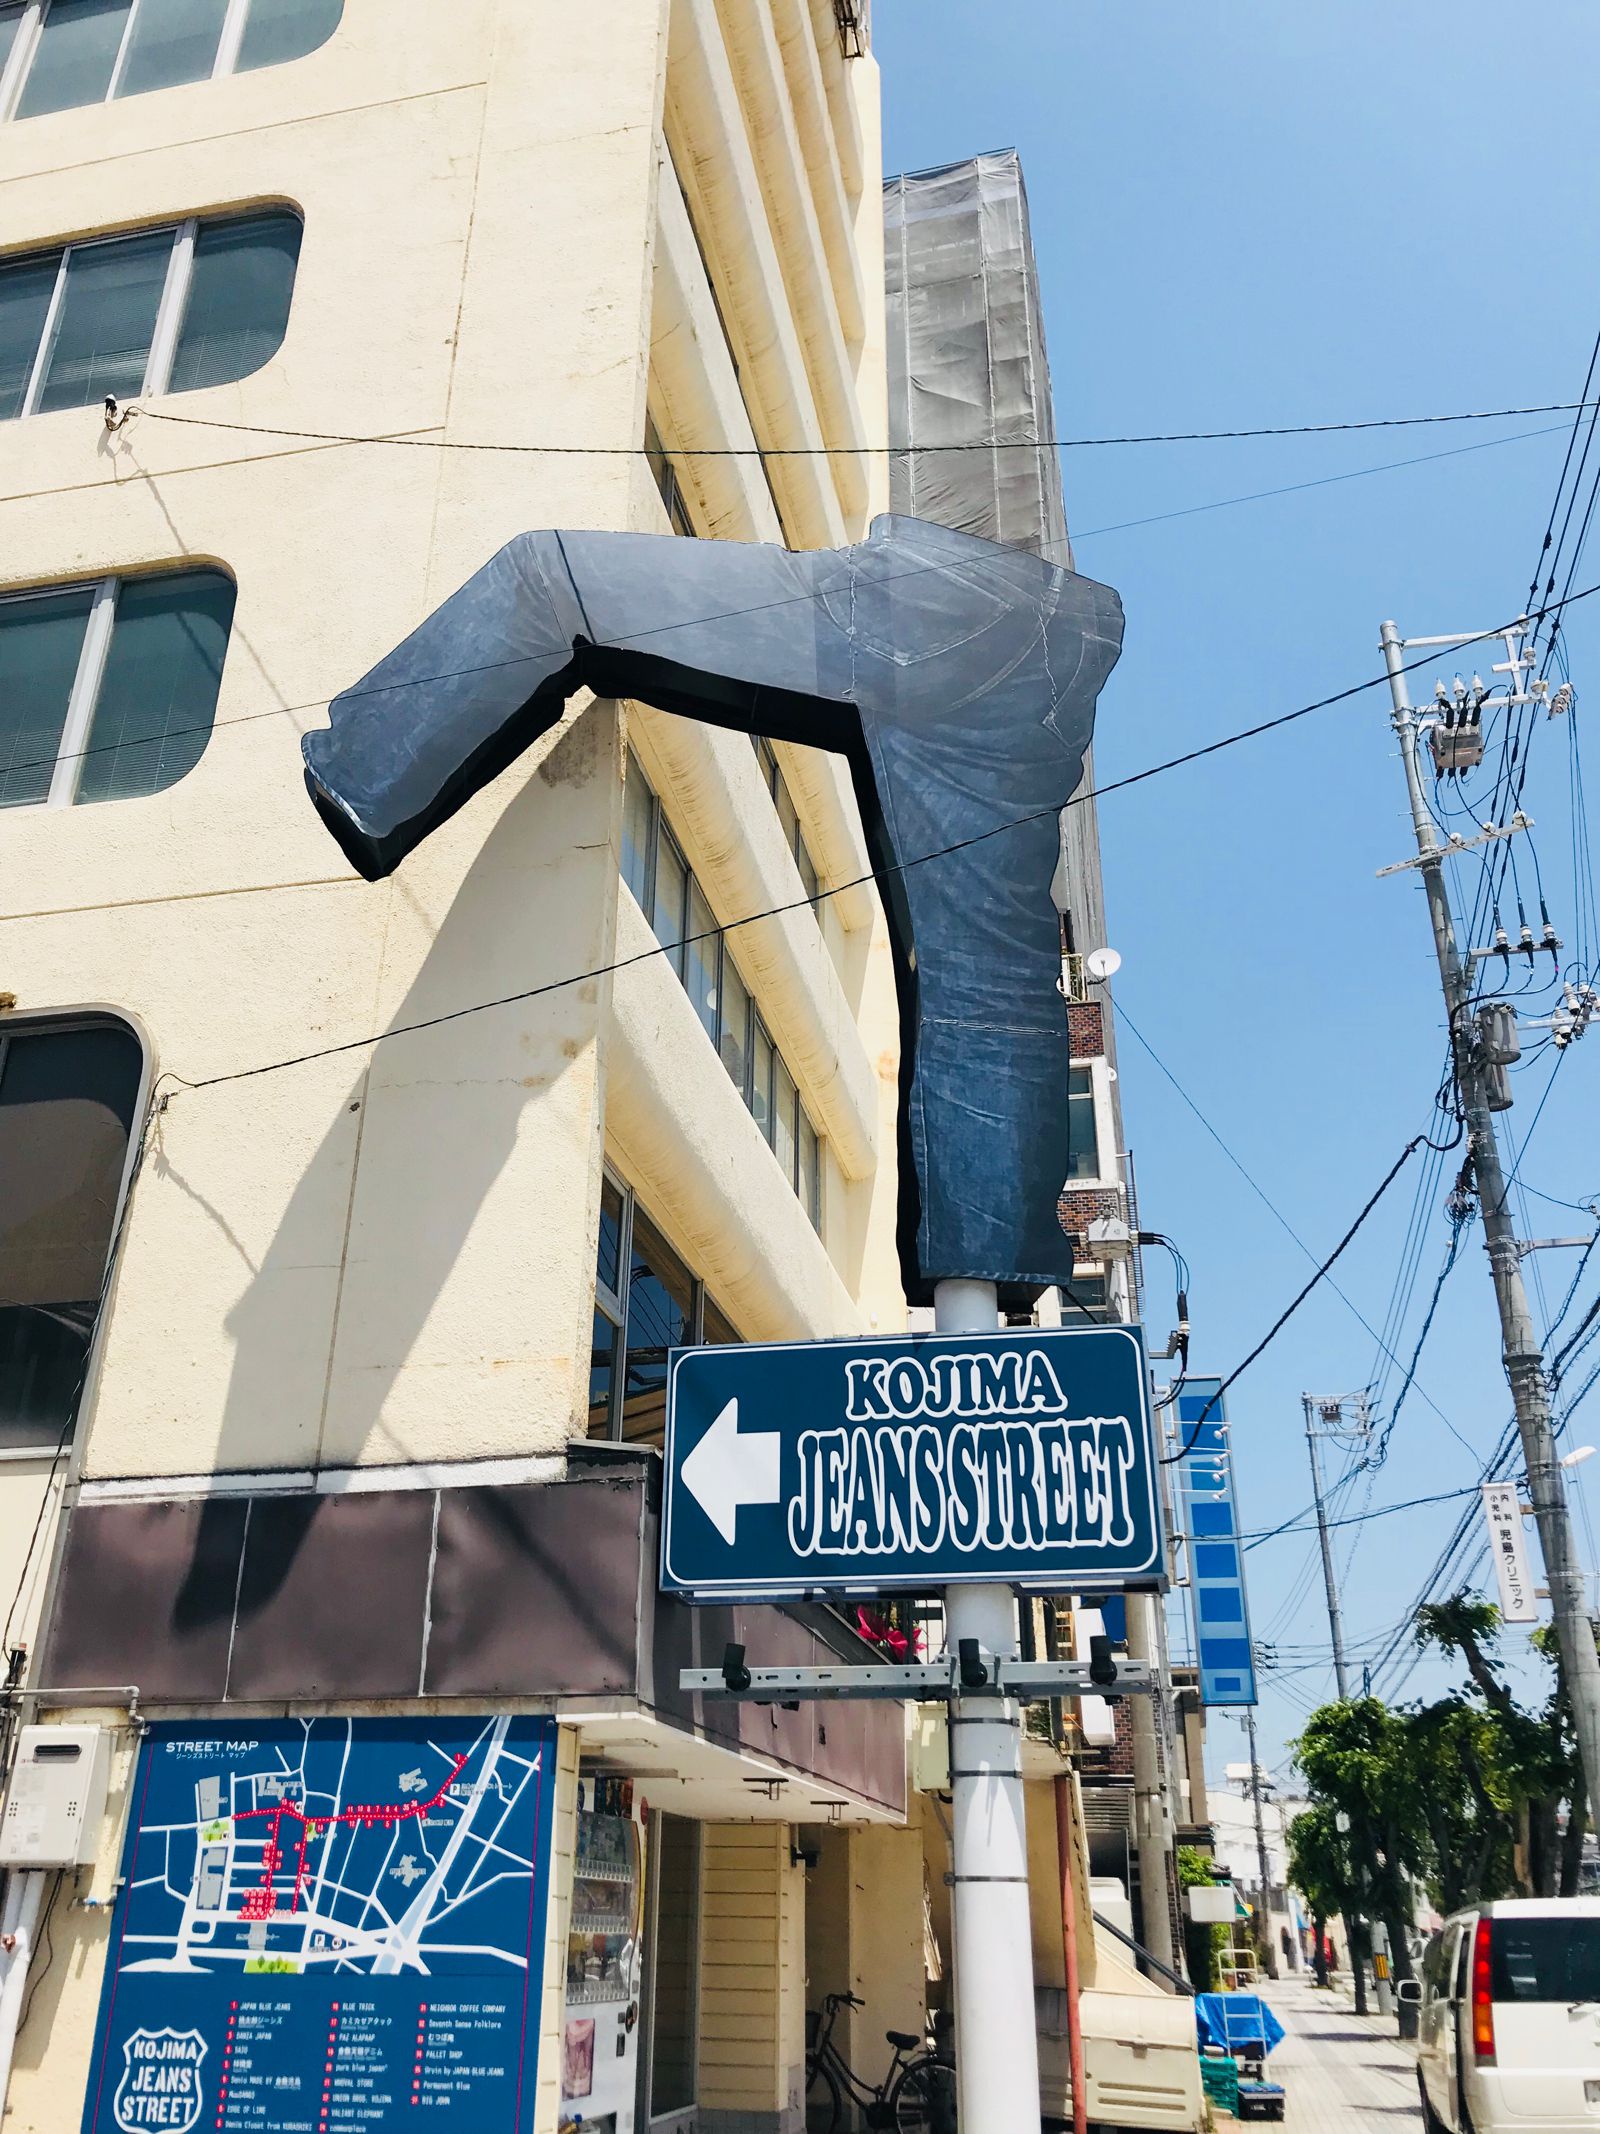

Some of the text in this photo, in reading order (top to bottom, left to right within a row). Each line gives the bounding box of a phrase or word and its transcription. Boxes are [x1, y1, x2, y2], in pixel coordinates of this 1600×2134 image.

[846, 1350, 1068, 1421] KOJIMA
[788, 1416, 1135, 1557] JEANS STREET
[1500, 1529, 1524, 1609] 児島クリニック
[166, 1740, 259, 1752] STREET MAP
[133, 2040, 197, 2060] KOJIMA
[131, 2065, 192, 2093] JEANS
[121, 2095, 195, 2124] STREET
